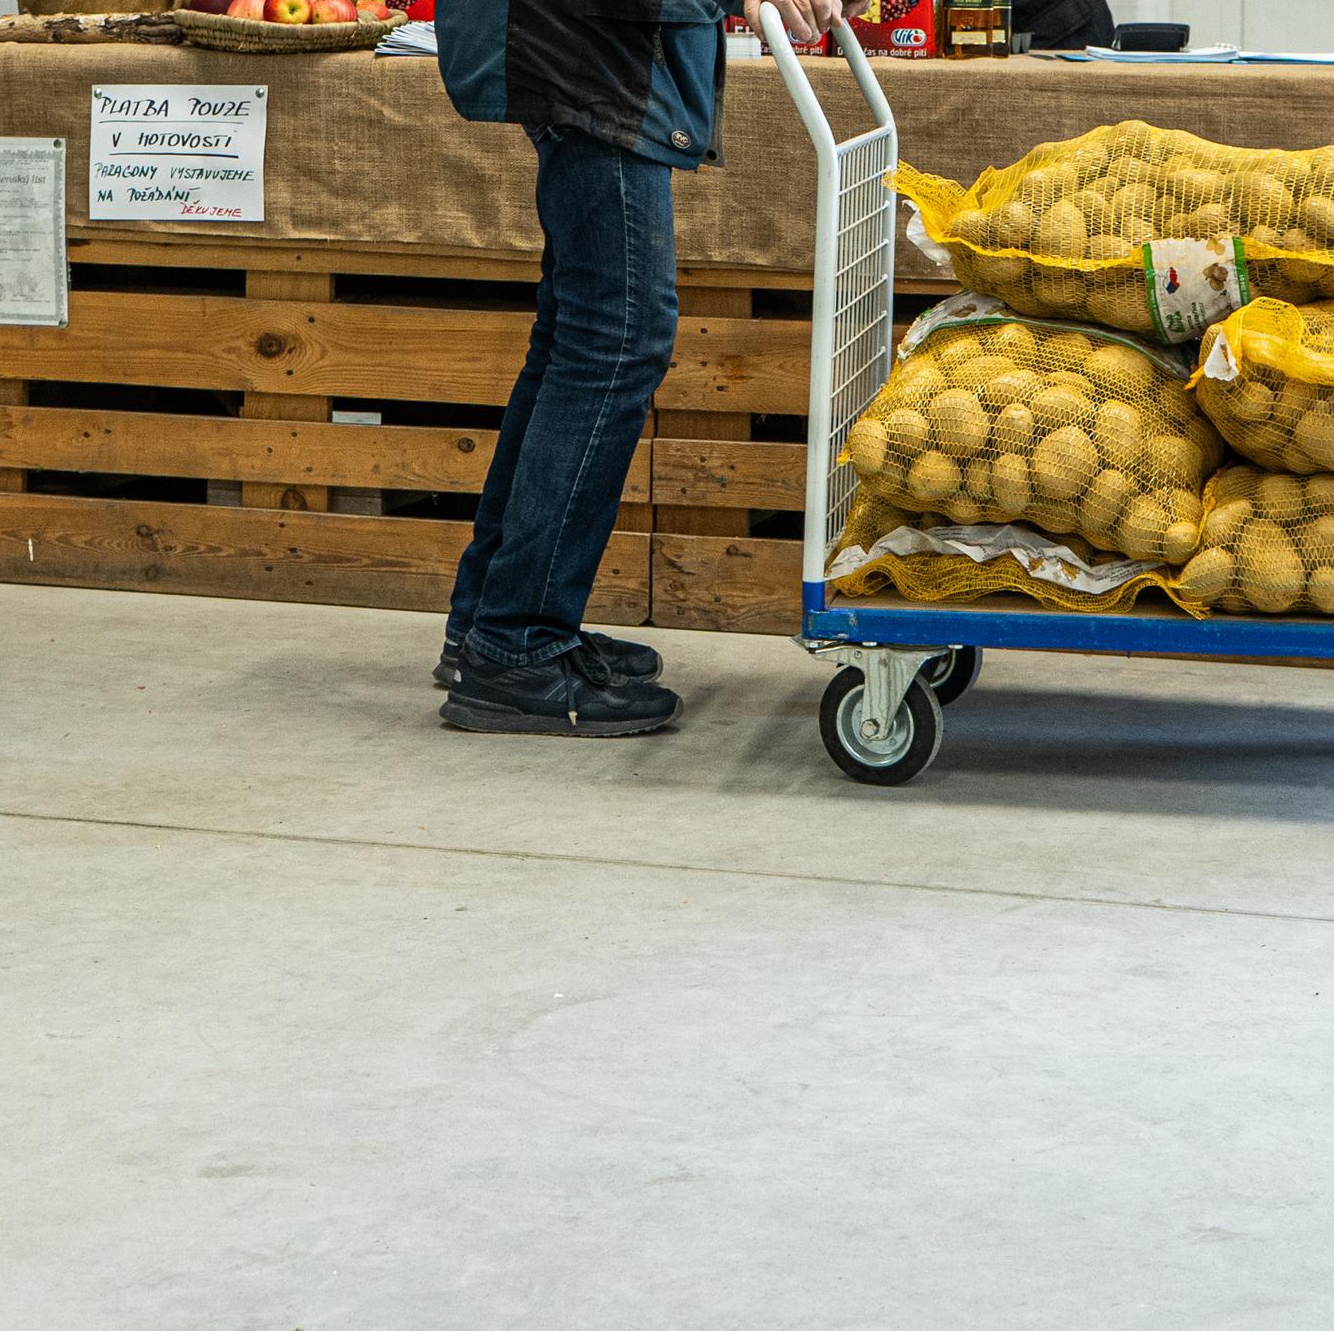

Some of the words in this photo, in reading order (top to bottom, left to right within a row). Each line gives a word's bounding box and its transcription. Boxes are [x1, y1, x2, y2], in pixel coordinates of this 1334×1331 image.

[890, 47, 912, 57] dobré
[913, 47, 927, 58] pití
[99, 96, 170, 117] PLATBA
[188, 97, 251, 117] POUZE
[112, 132, 122, 147] V
[170, 167, 255, 181] VYSTAVUJEME
[97, 189, 113, 202] NA
[179, 200, 243, 217] DĚKUJEME
